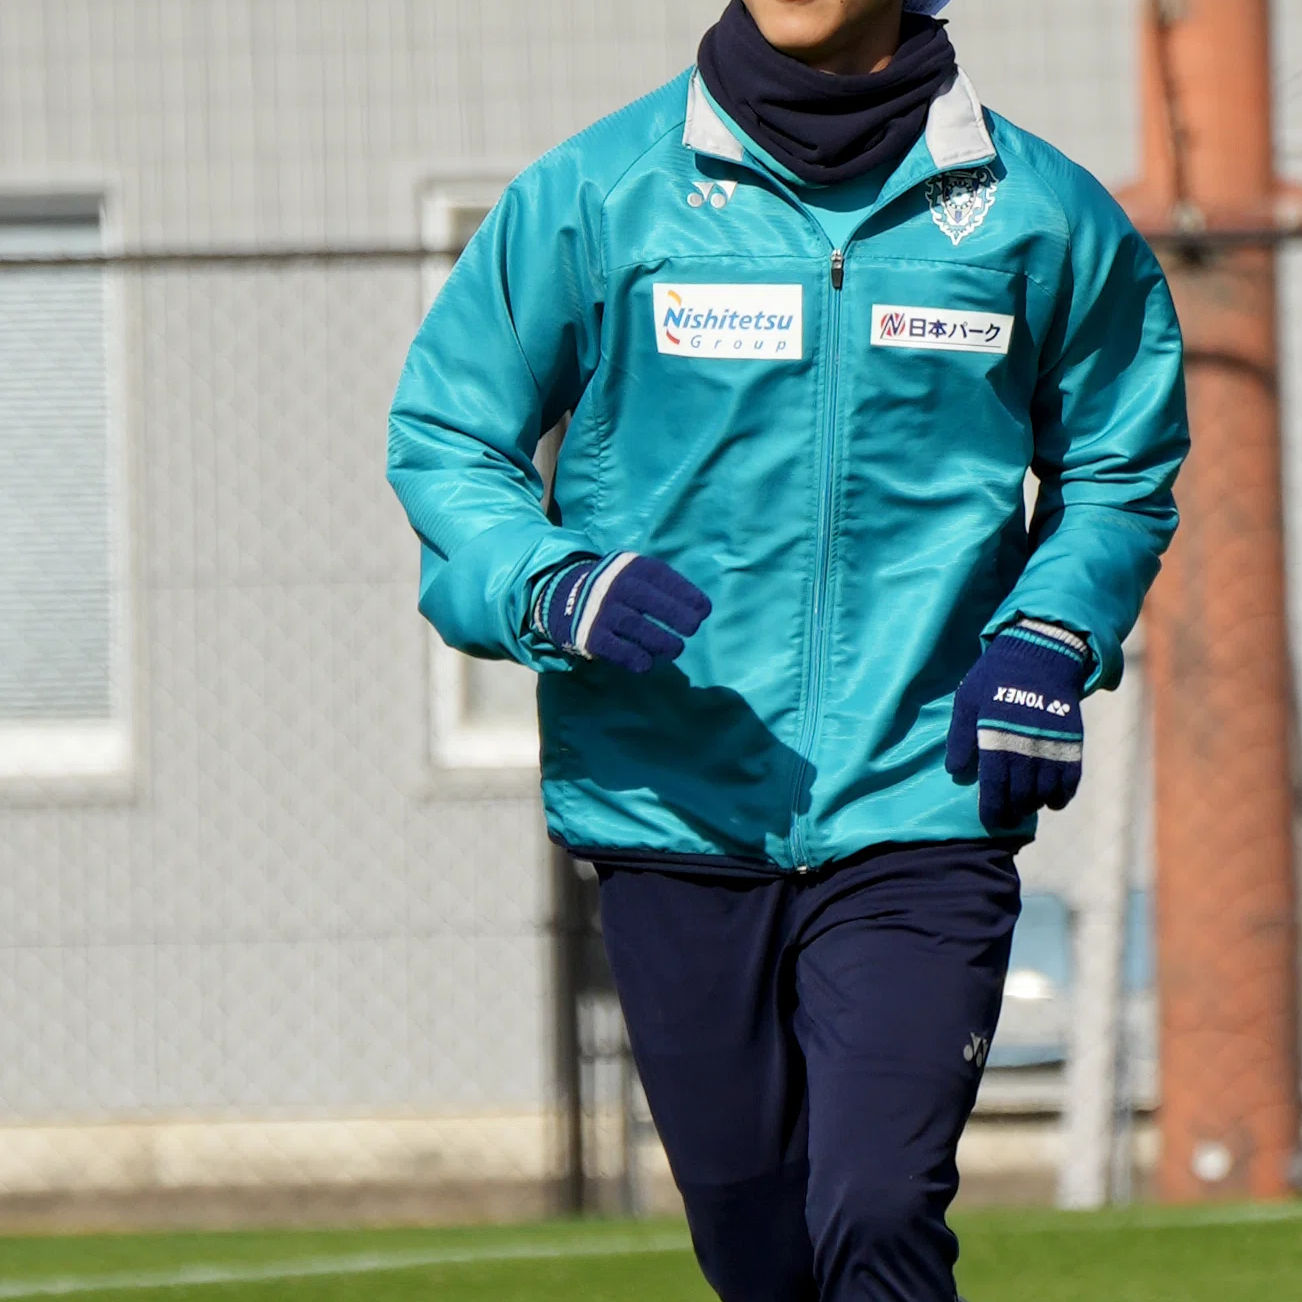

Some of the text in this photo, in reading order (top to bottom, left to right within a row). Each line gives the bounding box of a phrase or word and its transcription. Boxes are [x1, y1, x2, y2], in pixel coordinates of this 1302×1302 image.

[663, 306, 794, 332] Nishitetsu
[909, 318, 1002, 343] 日本パーク
[690, 335, 787, 353] Group
[993, 686, 1044, 711] YONEX
